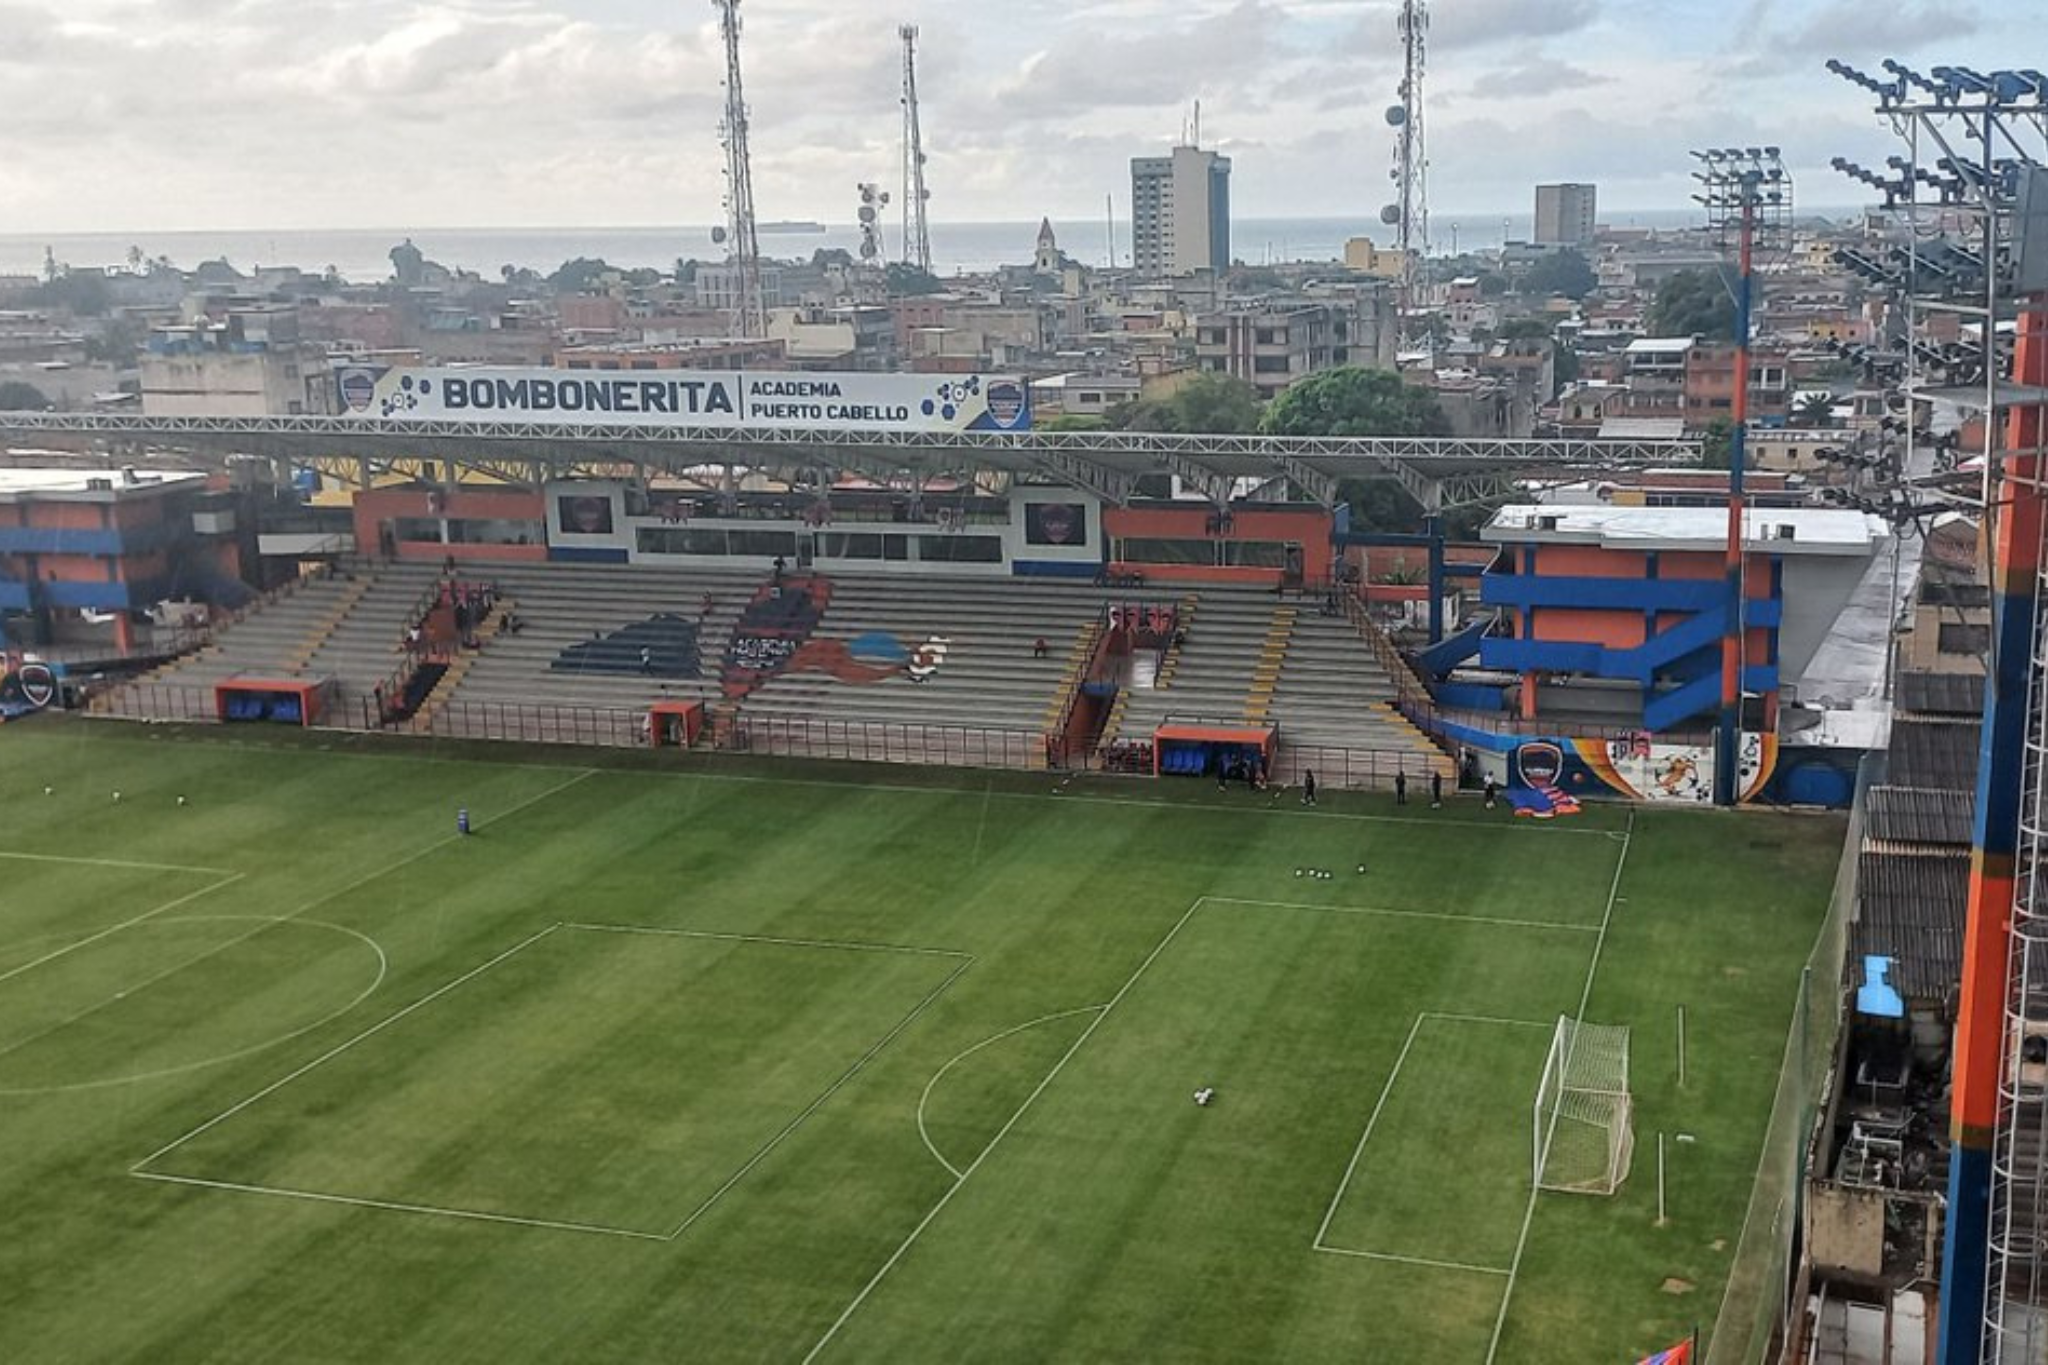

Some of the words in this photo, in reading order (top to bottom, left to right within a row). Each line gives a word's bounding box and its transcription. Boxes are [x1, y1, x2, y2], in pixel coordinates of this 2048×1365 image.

[443, 378, 733, 413] BOMBONERITA
[750, 381, 841, 397] ACADEMIA
[751, 403, 821, 419] PUERTO
[827, 405, 908, 421] CABELLO
